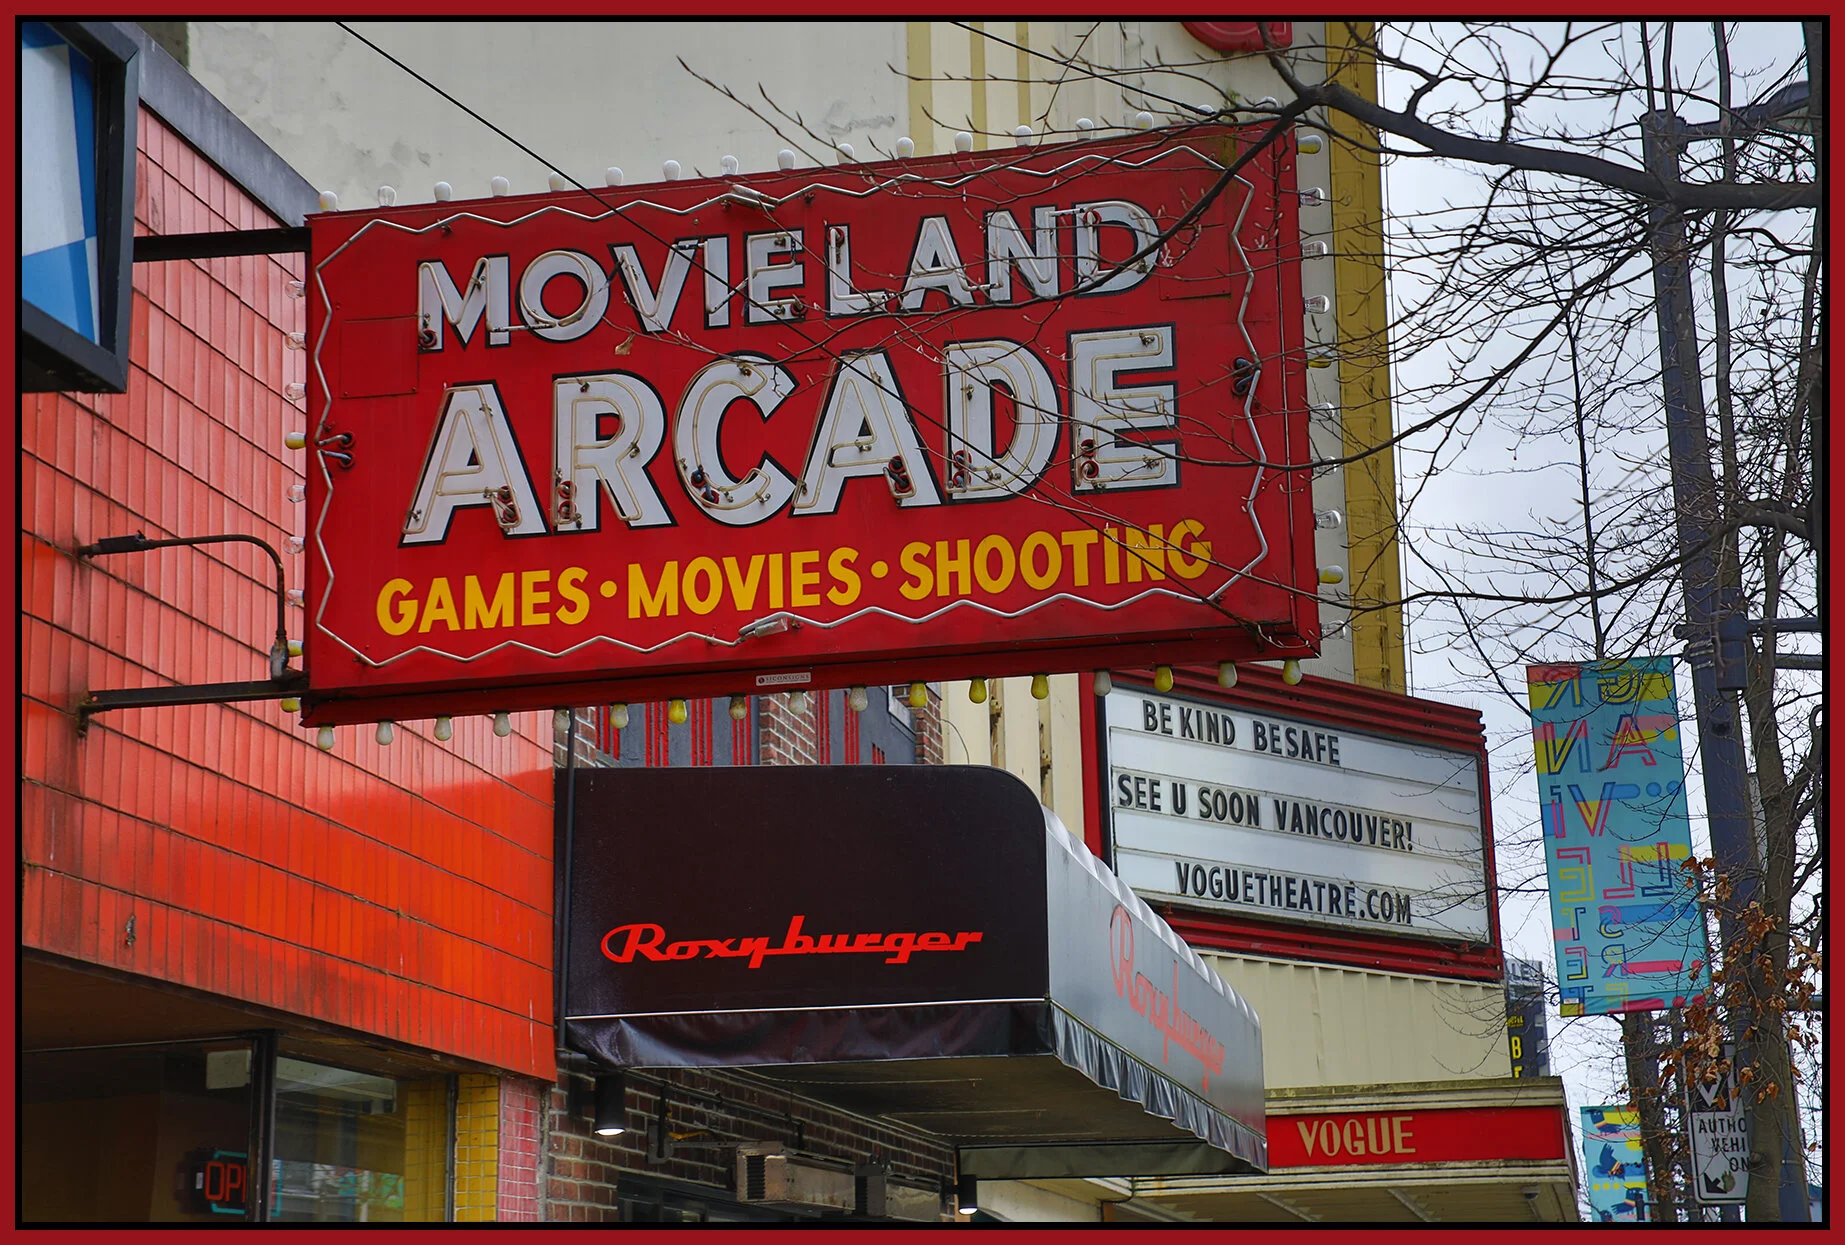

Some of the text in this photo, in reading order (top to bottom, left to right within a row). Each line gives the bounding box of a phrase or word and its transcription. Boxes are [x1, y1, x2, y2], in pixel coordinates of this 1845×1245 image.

[417, 199, 1161, 352] MOVIELAND
[400, 322, 1182, 548] ARCADE
[376, 518, 1213, 636] GAMES MOVIES SHOOTING
[1143, 700, 1173, 735] BE
[1179, 706, 1236, 746] KIND
[1117, 774, 1415, 852] SEE U SOON VANCOUVER!
[1175, 861, 1413, 925] VOGUETHEATRE.COM
[1296, 1116, 1417, 1157] VOGUE
